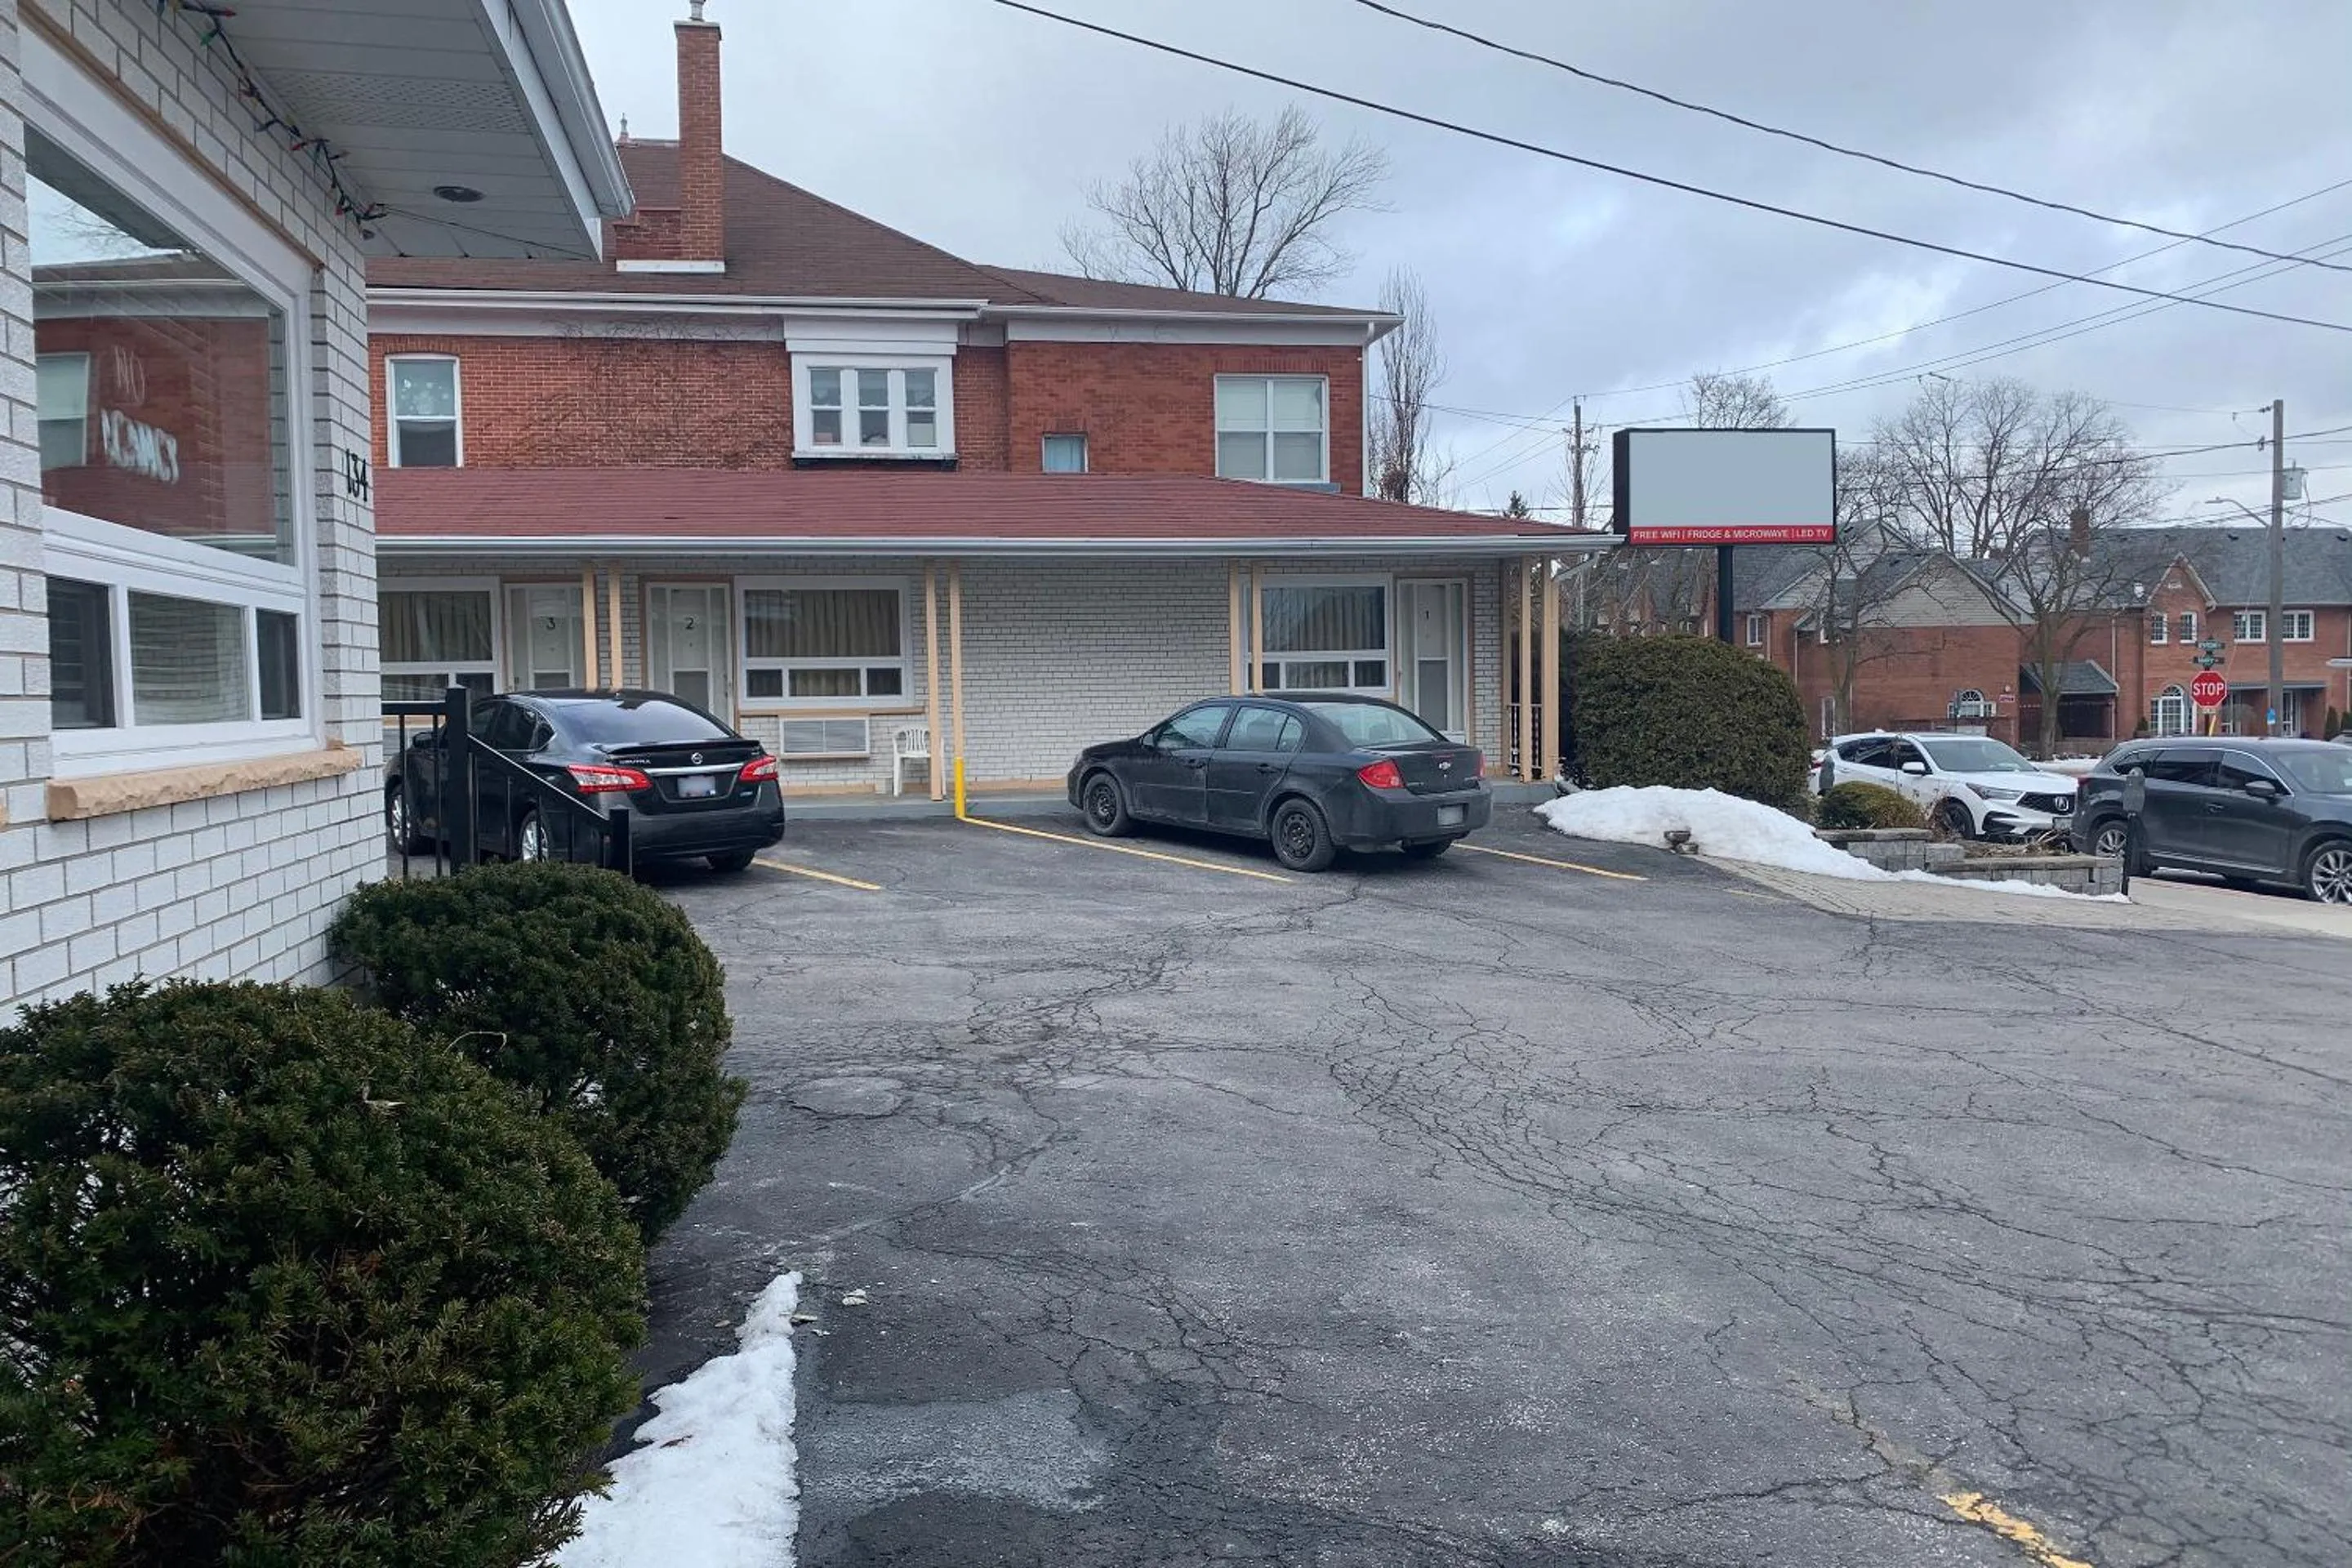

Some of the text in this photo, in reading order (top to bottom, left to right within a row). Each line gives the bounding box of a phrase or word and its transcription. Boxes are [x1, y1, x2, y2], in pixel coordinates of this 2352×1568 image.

[346, 448, 368, 501] 134
[1633, 528, 1829, 539] FREE WIFI FRIDGE & MICROWAVE LED TV
[546, 617, 556, 630] 3
[684, 617, 695, 630] 2
[2193, 682, 2225, 696] STOP
